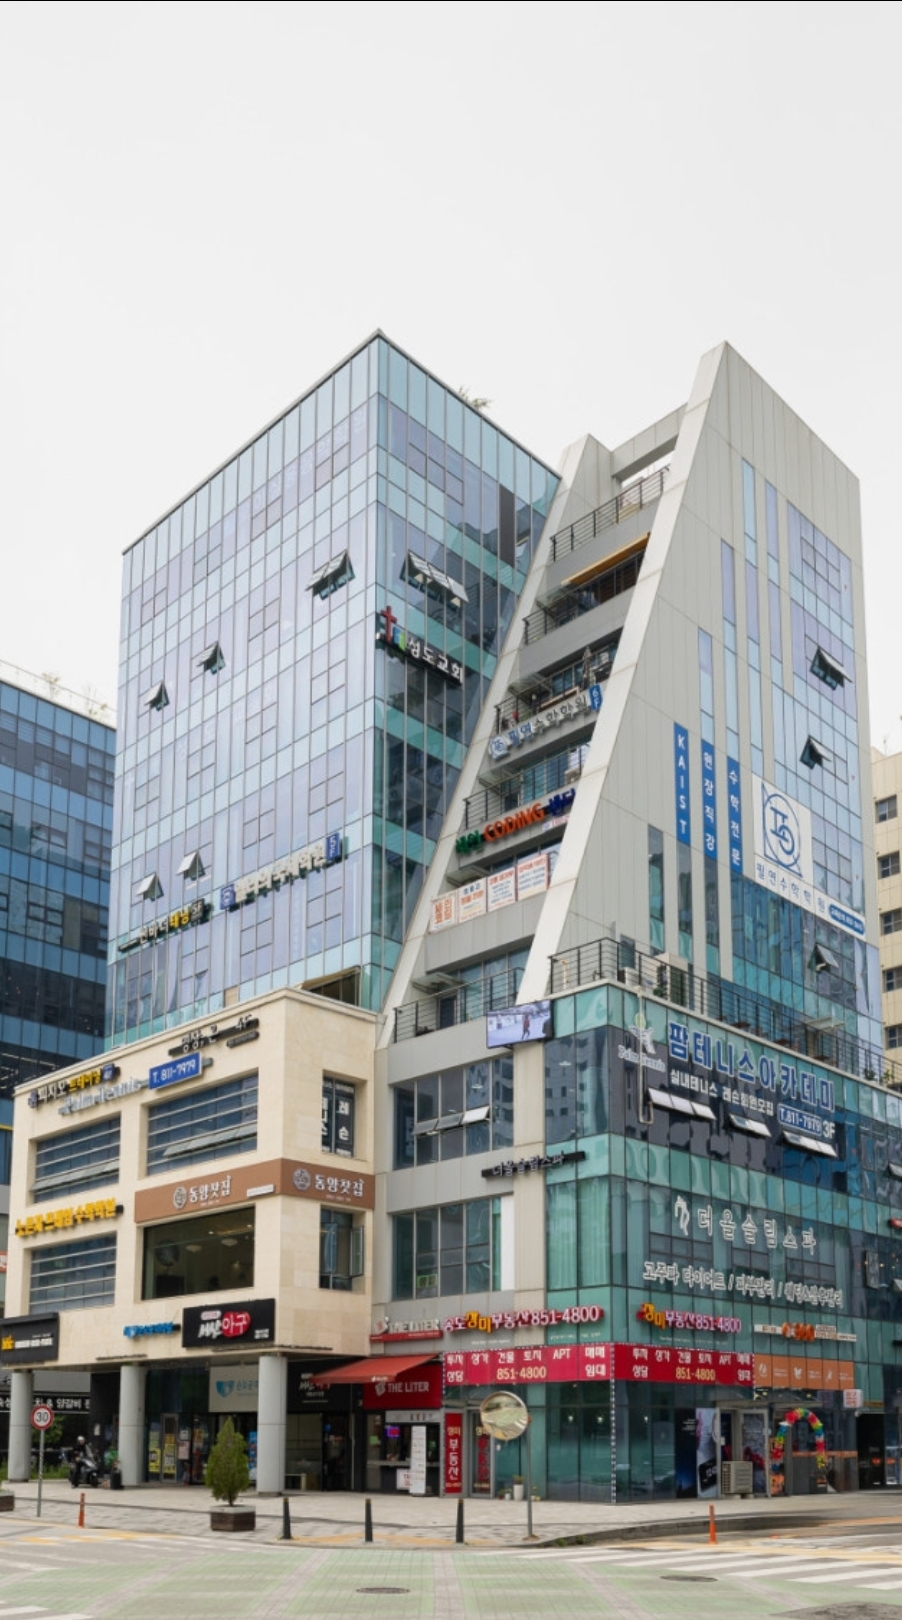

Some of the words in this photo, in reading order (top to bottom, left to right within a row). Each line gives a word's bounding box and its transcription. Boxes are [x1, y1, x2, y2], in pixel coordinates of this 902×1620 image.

[407, 637, 464, 683] 성도교회
[508, 694, 588, 748] 필연수학학원
[678, 734, 687, 834] KAIST
[703, 752, 715, 851] 원장직강
[729, 770, 740, 866] 수학전문
[756, 863, 826, 913] 필연수학학원
[669, 1021, 835, 1113] 팜테니스아카데미
[670, 1068, 718, 1098] 실내테니스
[822, 1119, 836, 1138] 3F
[697, 1204, 817, 1256] 더올슬림스파
[643, 1261, 680, 1286] 고주파
[682, 1264, 727, 1291] 다이어트
[447, 1354, 464, 1366] 투자
[471, 1352, 489, 1365] 상가
[498, 1351, 515, 1364] 건물
[523, 1350, 542, 1362] 토지
[553, 1348, 571, 1360] APT
[585, 1346, 605, 1359] 매매
[447, 1371, 464, 1383] 상담
[496, 1366, 547, 1380] 851-4800
[585, 1364, 606, 1377] 임대
[676, 1367, 715, 1381] 851-4800
[677, 1351, 691, 1364] 건물
[719, 1354, 732, 1365] APT
[388, 1383, 403, 1393] THE
[405, 1381, 430, 1392] LITER
[36, 1411, 49, 1423] 30
[448, 1438, 459, 1481] 부동산
